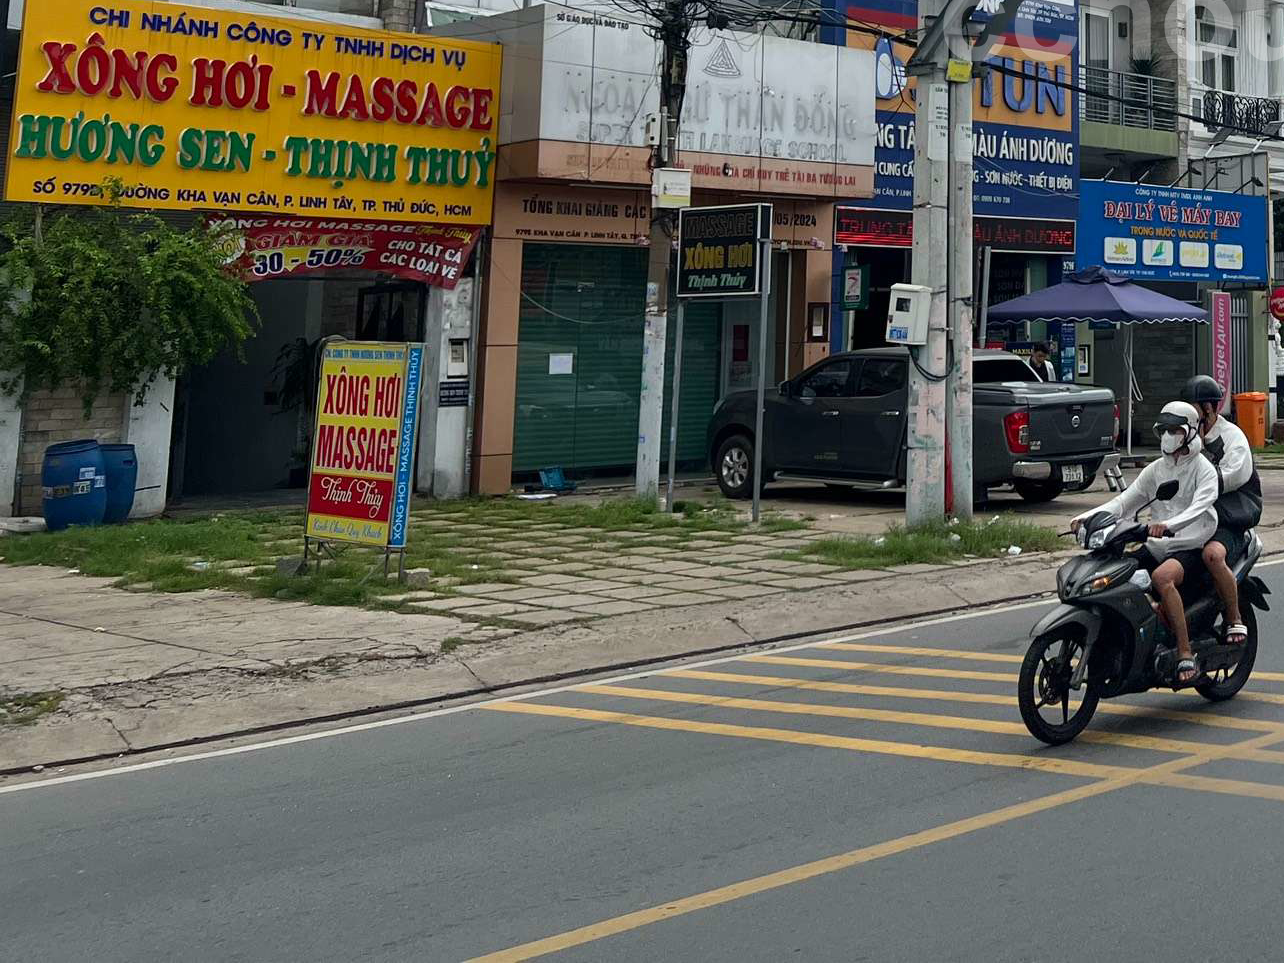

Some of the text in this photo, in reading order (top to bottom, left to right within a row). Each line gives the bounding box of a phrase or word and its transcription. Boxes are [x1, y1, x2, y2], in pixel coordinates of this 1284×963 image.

[89, 7, 466, 71] CHI NHÁNH CÔNG TY TNHH DỊCH VỤ
[37, 31, 179, 103] XÔNG
[188, 53, 274, 113] HƠI
[301, 68, 494, 132] MASSAGE
[14, 110, 165, 167] HƯƠNG
[176, 126, 256, 173] SEN
[284, 134, 398, 191] THỊNH
[404, 136, 496, 189] THUỶ
[898, 121, 915, 150] TÂ
[999, 130, 1027, 161] ÁNH
[1030, 136, 1073, 166] DƯƠNG
[878, 161, 901, 177] CUNG
[902, 159, 914, 177] CẤ
[32, 176, 57, 195] SỐ
[176, 188, 207, 204] KHA
[213, 190, 241, 207] VẠN
[246, 191, 280, 209] CÂN,
[284, 195, 294, 207] P.
[300, 196, 327, 209] LINH
[333, 195, 356, 211] TÂY,
[362, 200, 377, 212] TP.
[383, 198, 405, 213] THỦ
[410, 198, 439, 217] ĐỨC,
[444, 204, 472, 217] HCM
[522, 194, 553, 215] TỔNG
[556, 200, 582, 216] KHAI
[317, 221, 417, 234] MASSAGE
[684, 213, 754, 239] MASSAGE
[1104, 198, 1242, 228] ĐẠI LÝ VÉ MÁY BAY
[388, 239, 416, 252] CHO
[684, 242, 724, 271] XÔNG
[252, 251, 284, 276] 30
[306, 248, 366, 269] 50%
[688, 273, 718, 291] Thịnh
[323, 366, 370, 415] XÔNG
[374, 372, 400, 418] HƠI
[316, 424, 397, 474] MASSAGE
[401, 416, 414, 472] MASSAGE
[321, 477, 357, 505] Thịnh
